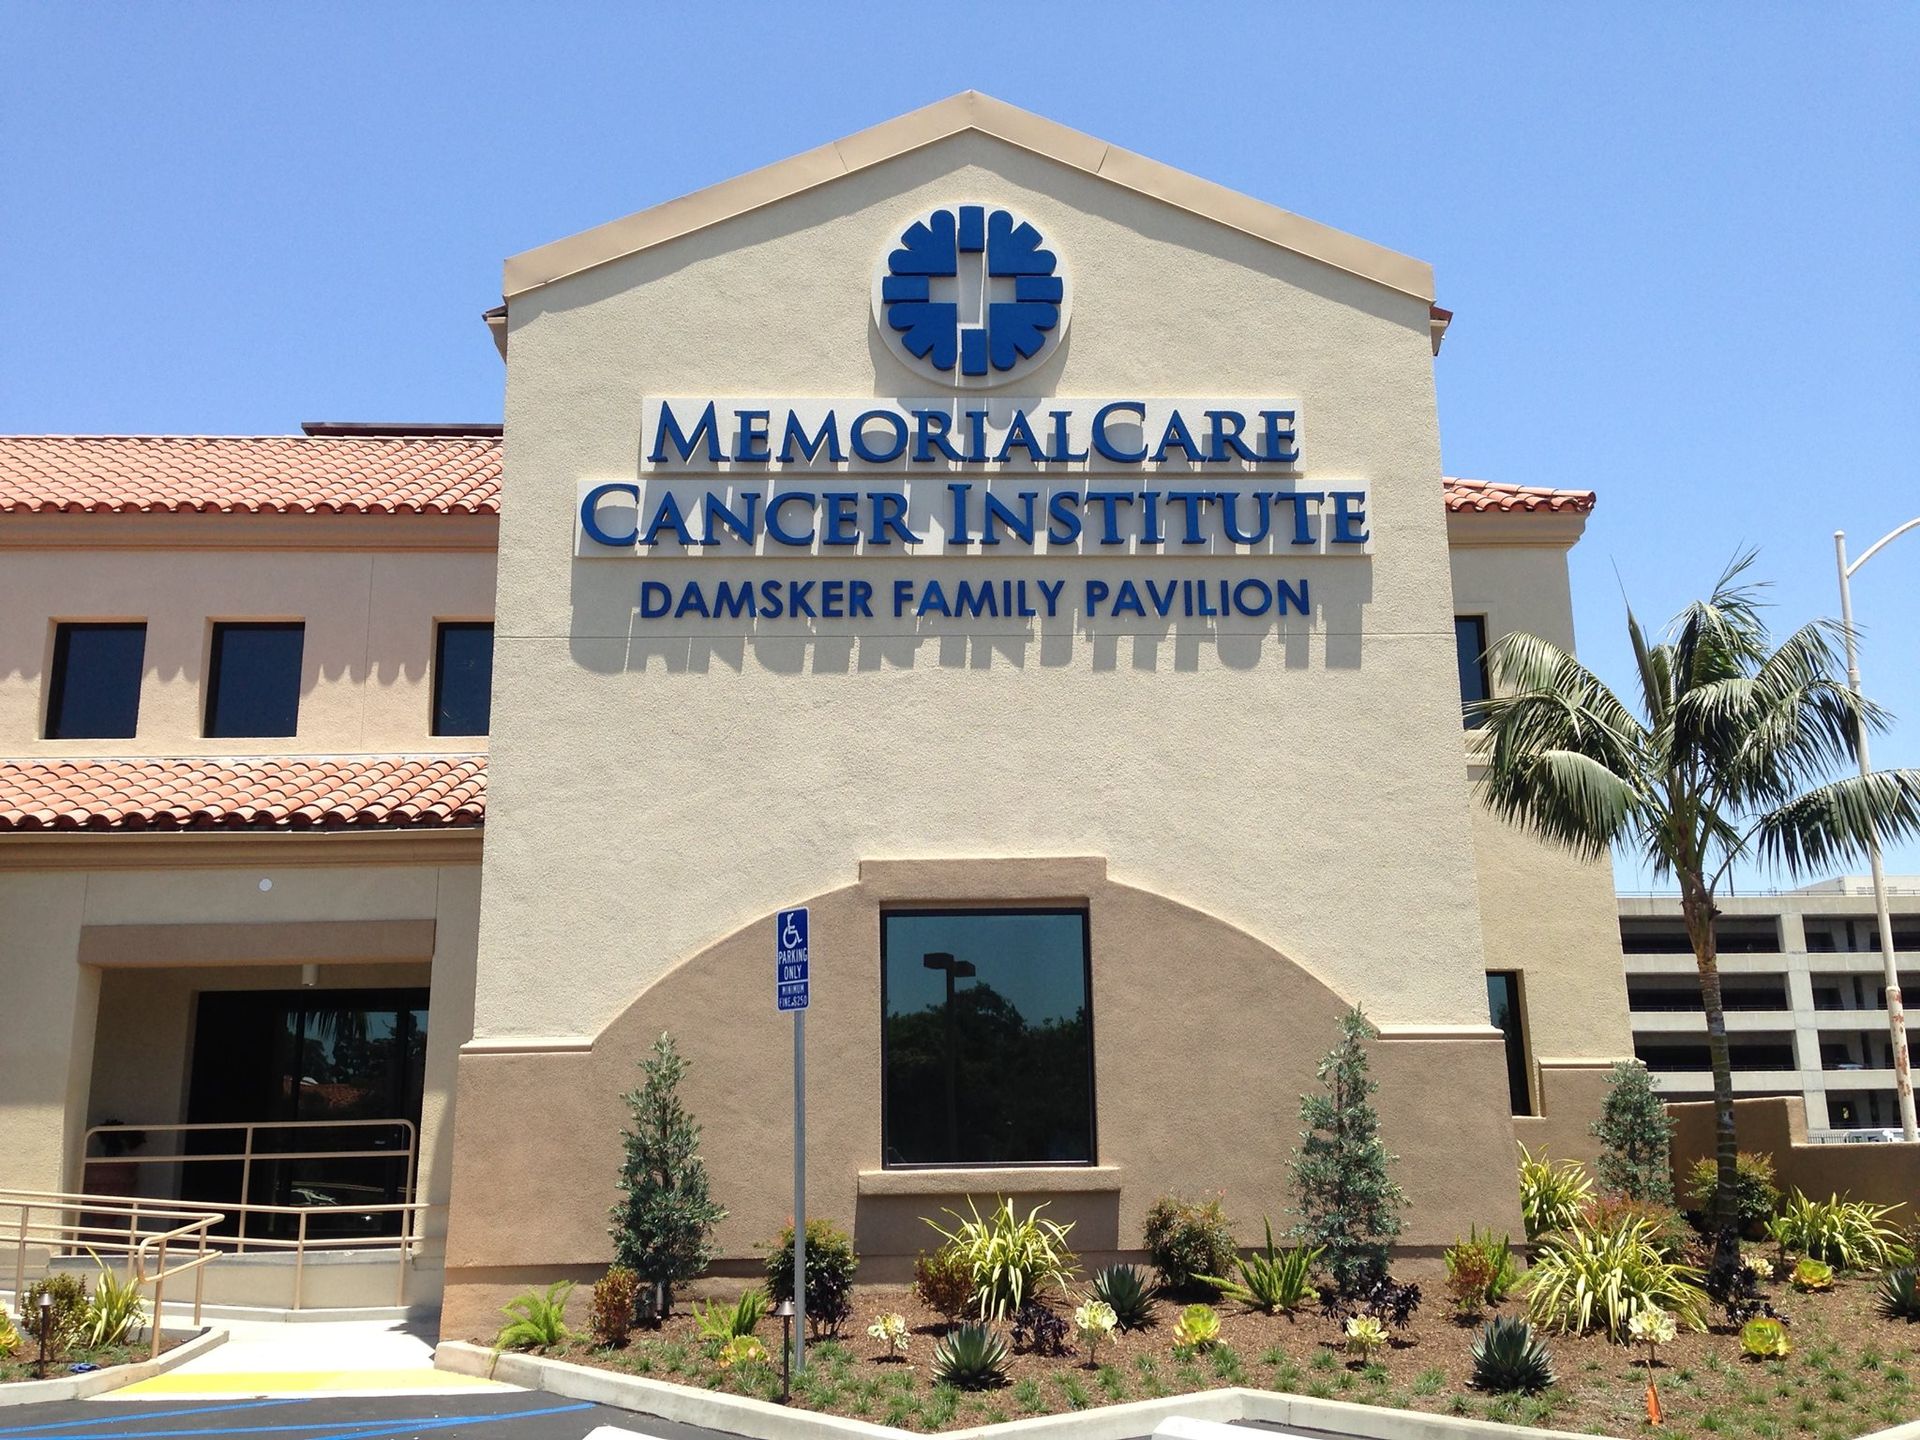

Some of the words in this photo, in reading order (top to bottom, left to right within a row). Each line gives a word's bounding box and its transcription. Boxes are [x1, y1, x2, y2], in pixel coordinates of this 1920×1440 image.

[580, 483, 922, 547] CANCER
[946, 483, 1370, 546] INSTITUTE
[640, 579, 874, 619] DAMSKER
[892, 579, 1066, 618] FAMILY
[1085, 578, 1310, 618] PAVILION
[778, 948, 807, 964] PARKING
[783, 965, 802, 980] ONLY
